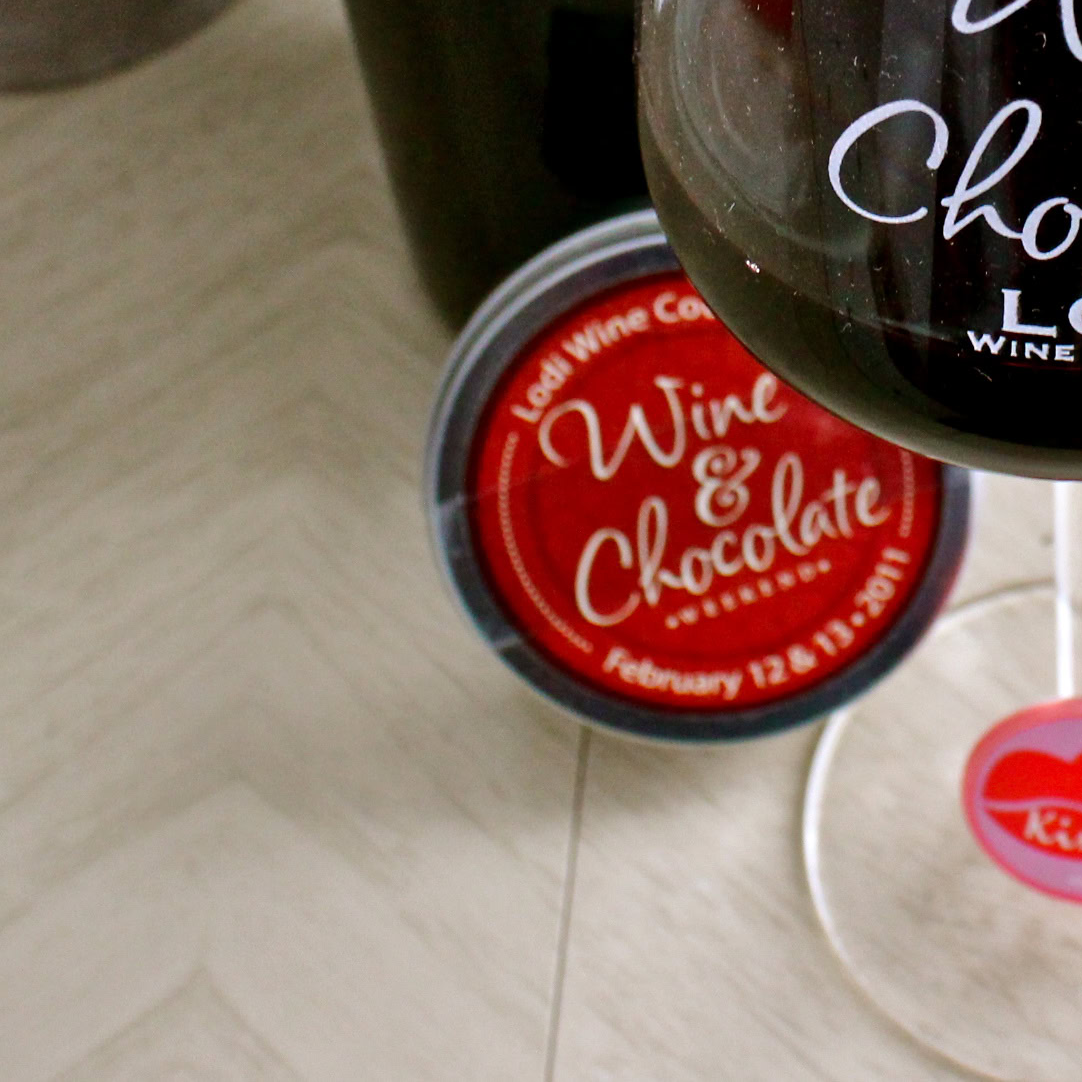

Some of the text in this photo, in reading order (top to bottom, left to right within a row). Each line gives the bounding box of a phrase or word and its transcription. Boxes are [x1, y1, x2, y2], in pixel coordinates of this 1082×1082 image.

[510, 352, 574, 424] Lodi
[561, 306, 651, 363] Wine
[966, 328, 1076, 363] WINE
[538, 371, 791, 482] Wine
[574, 450, 893, 628] Chocolate
[692, 444, 762, 528] &
[602, 646, 744, 701] February
[748, 653, 790, 689] 12
[786, 642, 818, 675] &
[812, 618, 856, 667] 13
[853, 545, 912, 619] 2011
